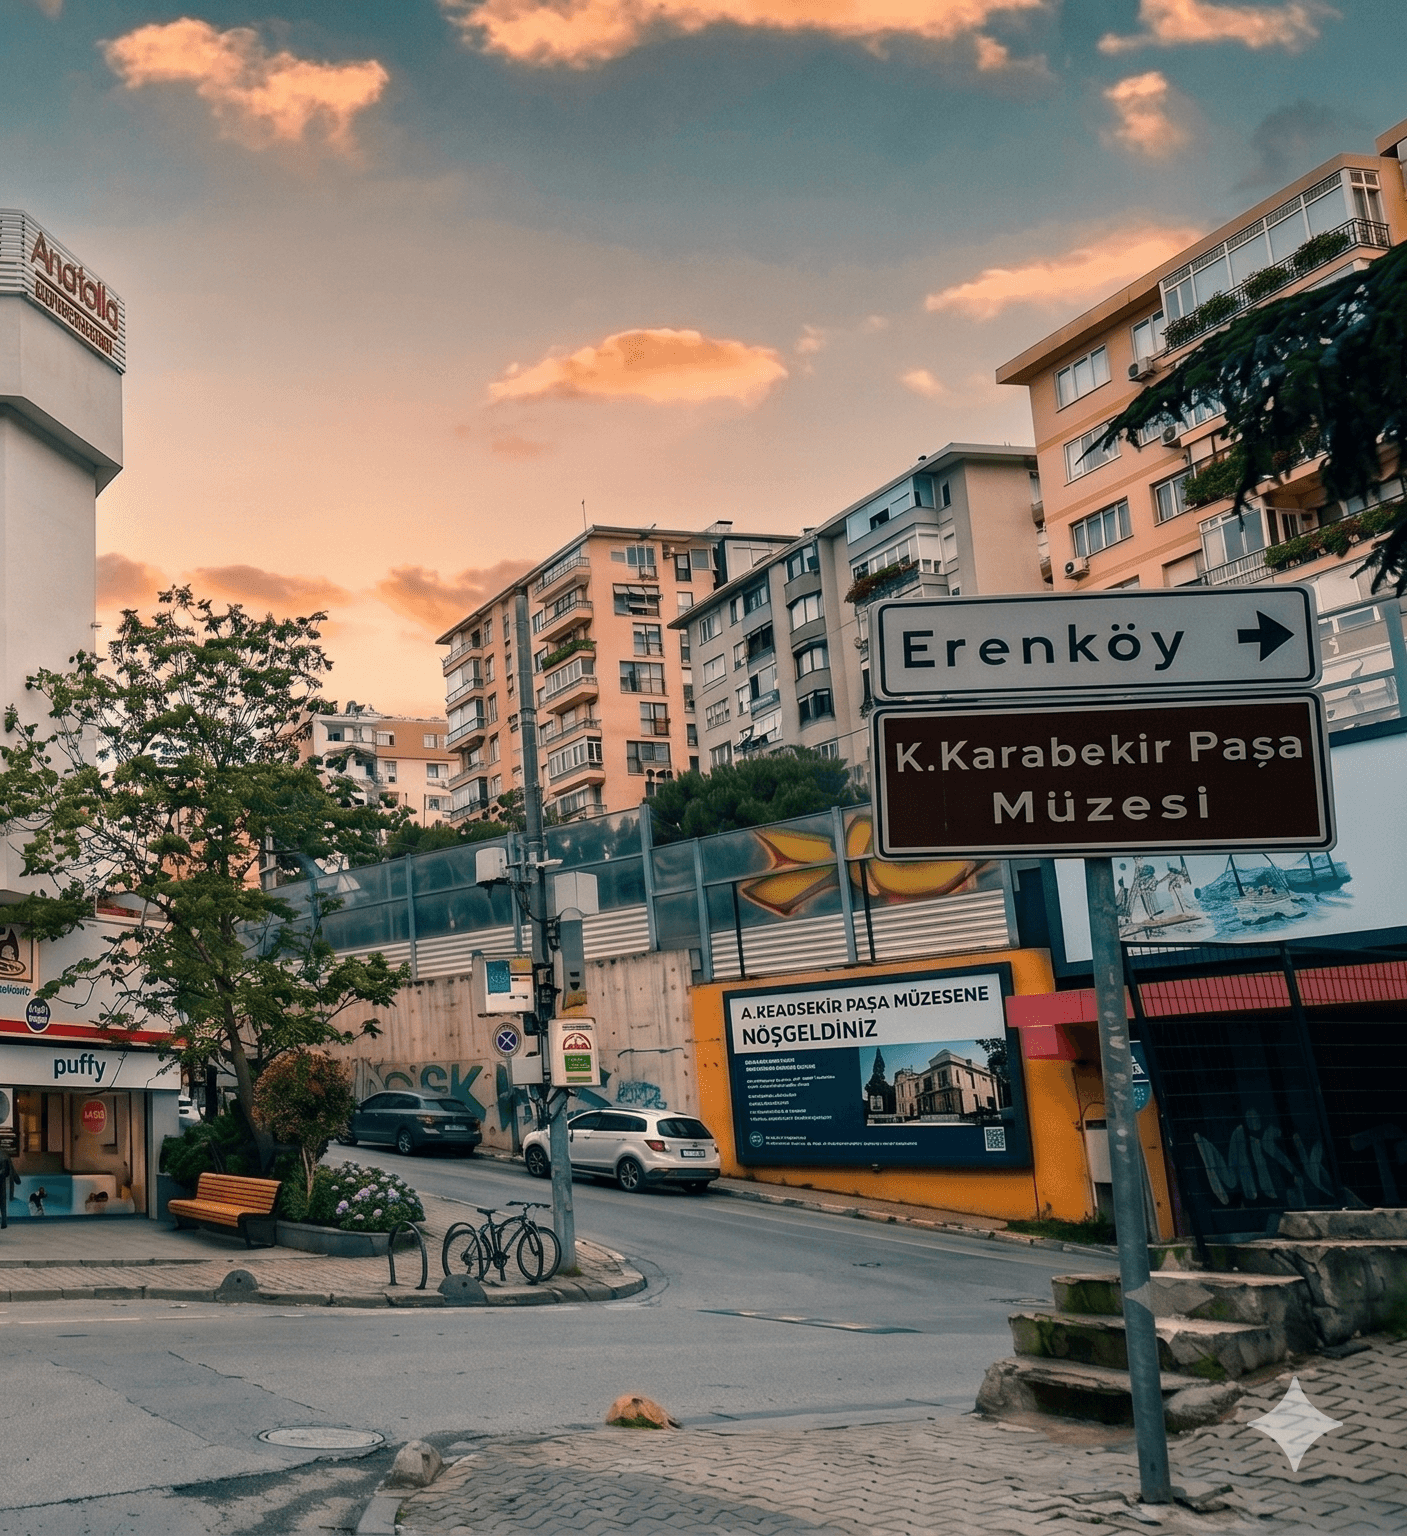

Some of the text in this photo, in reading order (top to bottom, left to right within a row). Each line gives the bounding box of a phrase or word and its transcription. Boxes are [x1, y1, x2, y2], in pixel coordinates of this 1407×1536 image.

[902, 623, 1185, 671] Erenköy
[896, 730, 1303, 773] K.Karabekir Paşa
[993, 785, 1209, 825] Müzesi
[846, 995, 890, 1014] PAŞA
[893, 985, 989, 1009] MÜZESENE
[742, 1017, 879, 1048] NÖŞGELDİNİZ
[53, 1053, 107, 1083] puffy
